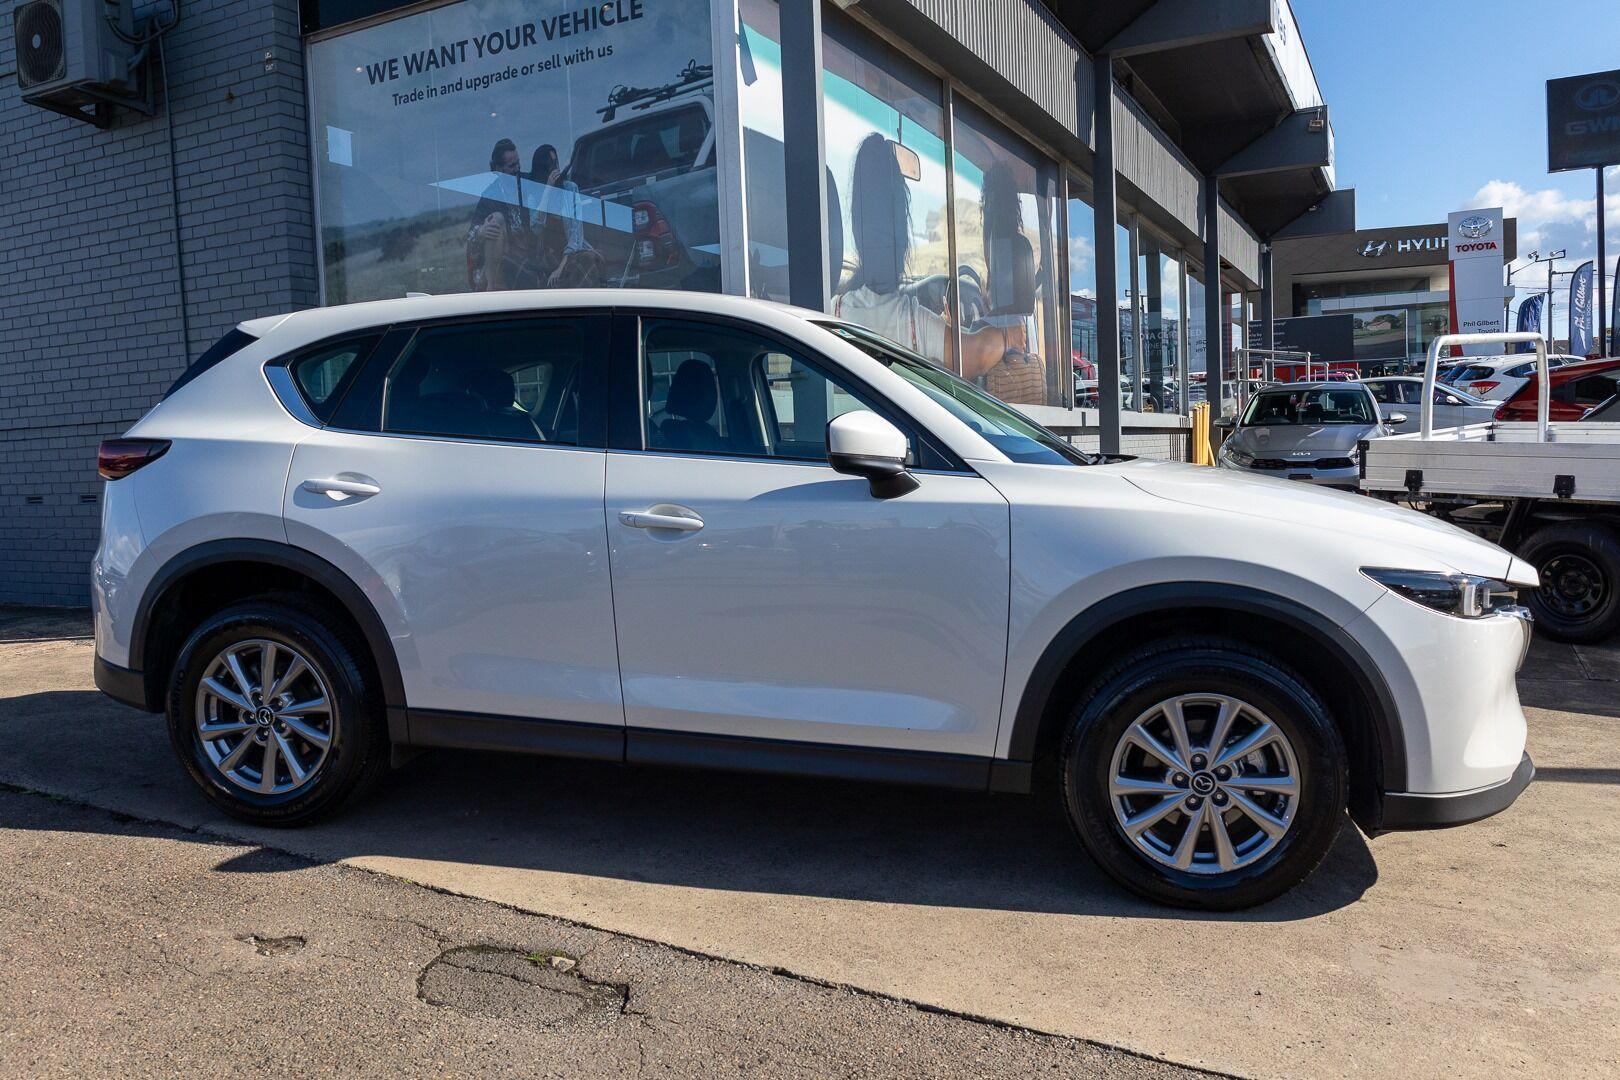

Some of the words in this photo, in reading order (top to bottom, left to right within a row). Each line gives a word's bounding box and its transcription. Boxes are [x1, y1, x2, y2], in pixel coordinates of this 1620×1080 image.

[366, 58, 399, 85] WE
[403, 41, 469, 76] WANT
[472, 23, 537, 58] YOUR
[541, 0, 643, 41] VEHICLE
[392, 88, 424, 106] Trade
[427, 85, 438, 99] in
[440, 77, 463, 96] and
[466, 66, 518, 91] upgrade
[521, 64, 535, 76] or
[537, 53, 562, 73] sell
[564, 46, 594, 66] with
[597, 45, 614, 58] us
[1455, 241, 1497, 253] TOYOTA
[1476, 319, 1500, 327] Gilbert
